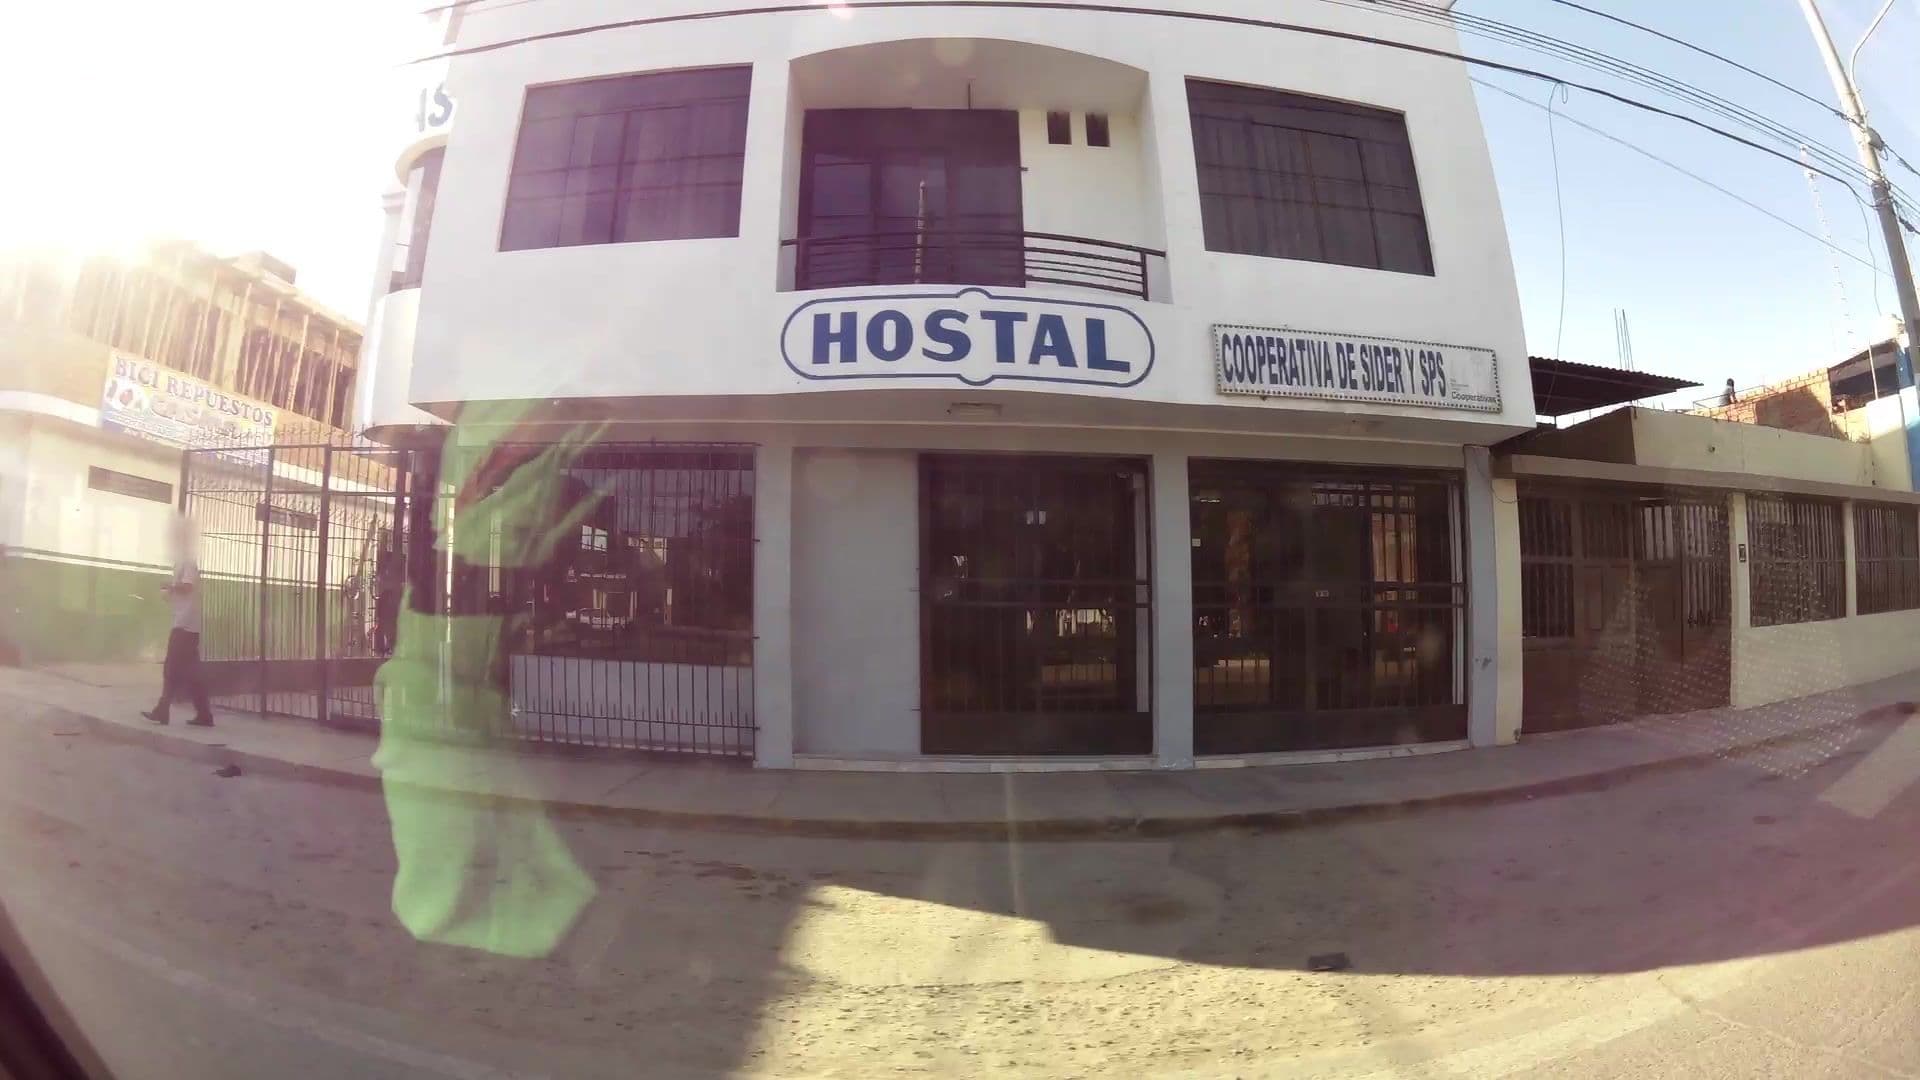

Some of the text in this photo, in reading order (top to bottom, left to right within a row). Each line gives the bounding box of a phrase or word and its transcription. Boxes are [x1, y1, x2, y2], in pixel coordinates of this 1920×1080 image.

[812, 309, 1131, 373] HOSTAL
[1221, 333, 1447, 398] COOPERATIVA DE SIDER Y SPS
[115, 356, 159, 389] BICI
[166, 374, 273, 427] REPUESTOS
